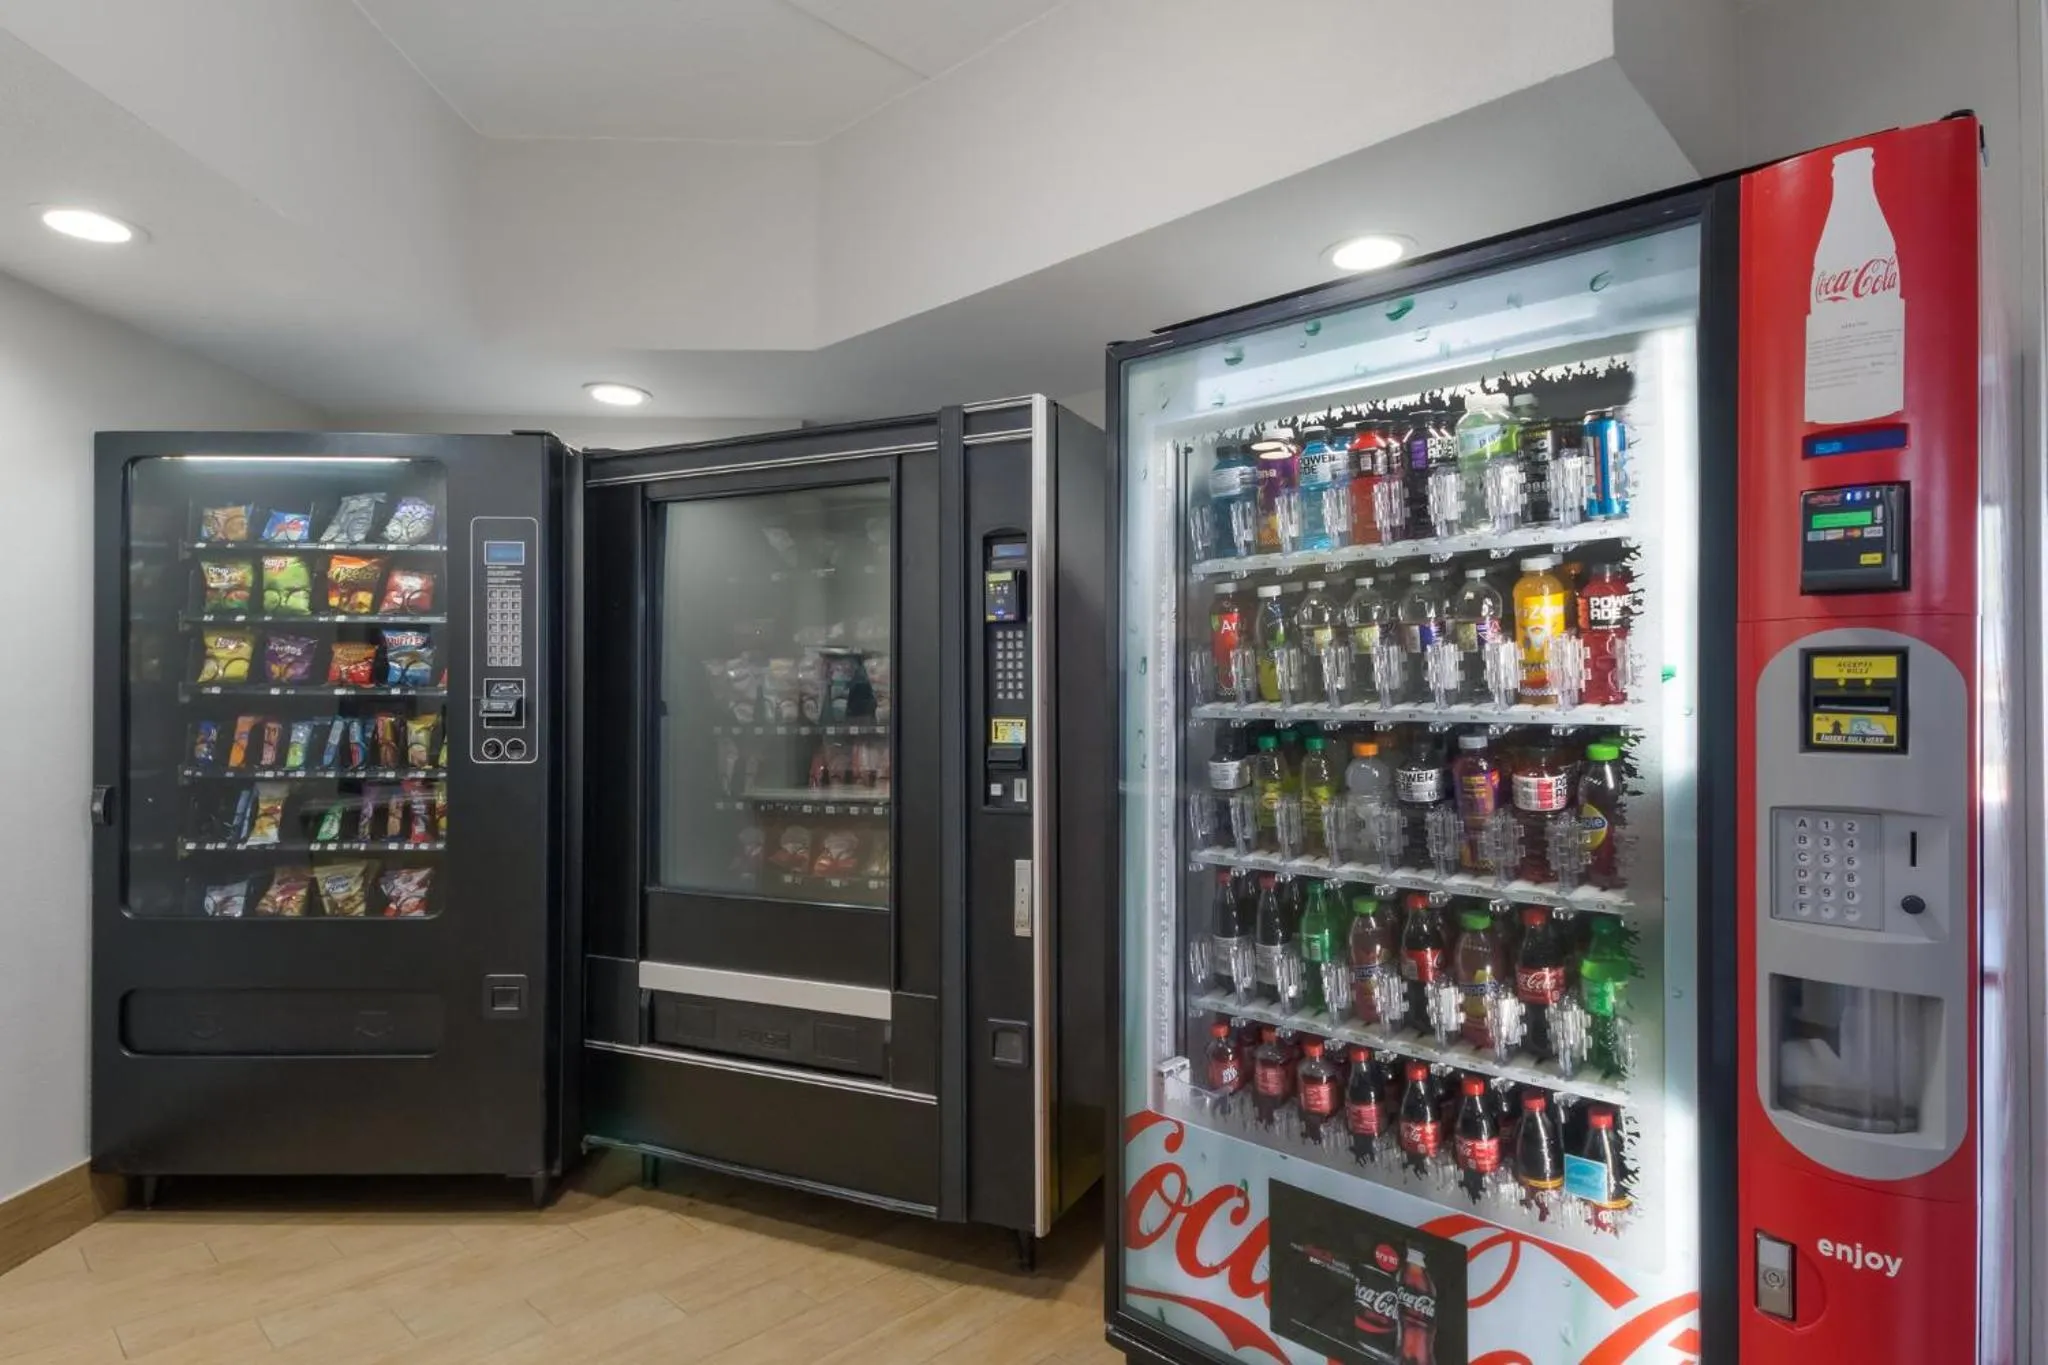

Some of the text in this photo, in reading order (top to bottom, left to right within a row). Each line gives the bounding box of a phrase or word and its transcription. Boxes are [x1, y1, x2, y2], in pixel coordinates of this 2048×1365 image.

[1815, 258, 1898, 304] Coca-Cola
[1798, 819, 1855, 831] A 1 2
[1798, 836, 1855, 848] B 3 4
[1798, 853, 1855, 866] C 5 6
[1823, 872, 1830, 880] 7
[1847, 873, 1855, 883] 8
[1823, 888, 1830, 897] 9
[1798, 903, 1807, 912] F
[1817, 1237, 1903, 1278] enjoy
